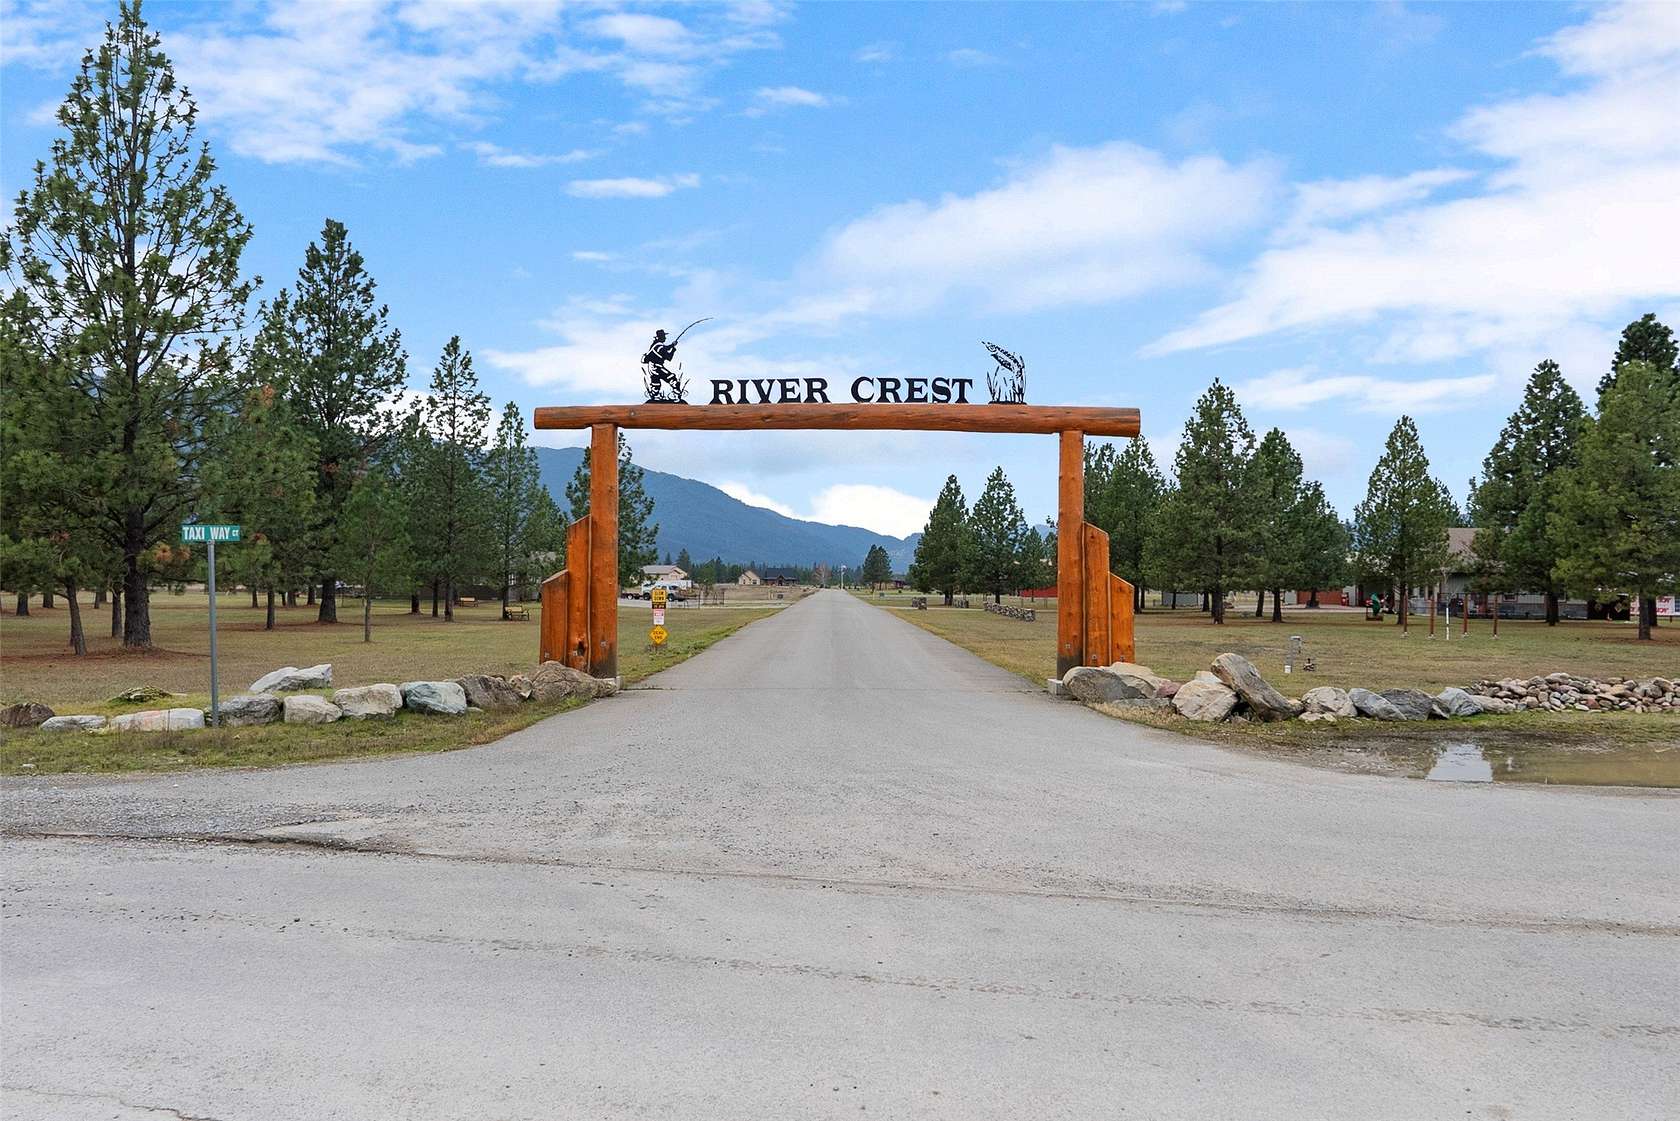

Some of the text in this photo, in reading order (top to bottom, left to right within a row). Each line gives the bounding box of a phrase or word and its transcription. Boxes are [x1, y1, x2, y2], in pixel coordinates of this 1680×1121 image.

[708, 376, 973, 405] RIVER CREST
[182, 526, 205, 540] TAXI
[210, 526, 230, 540] WAY
